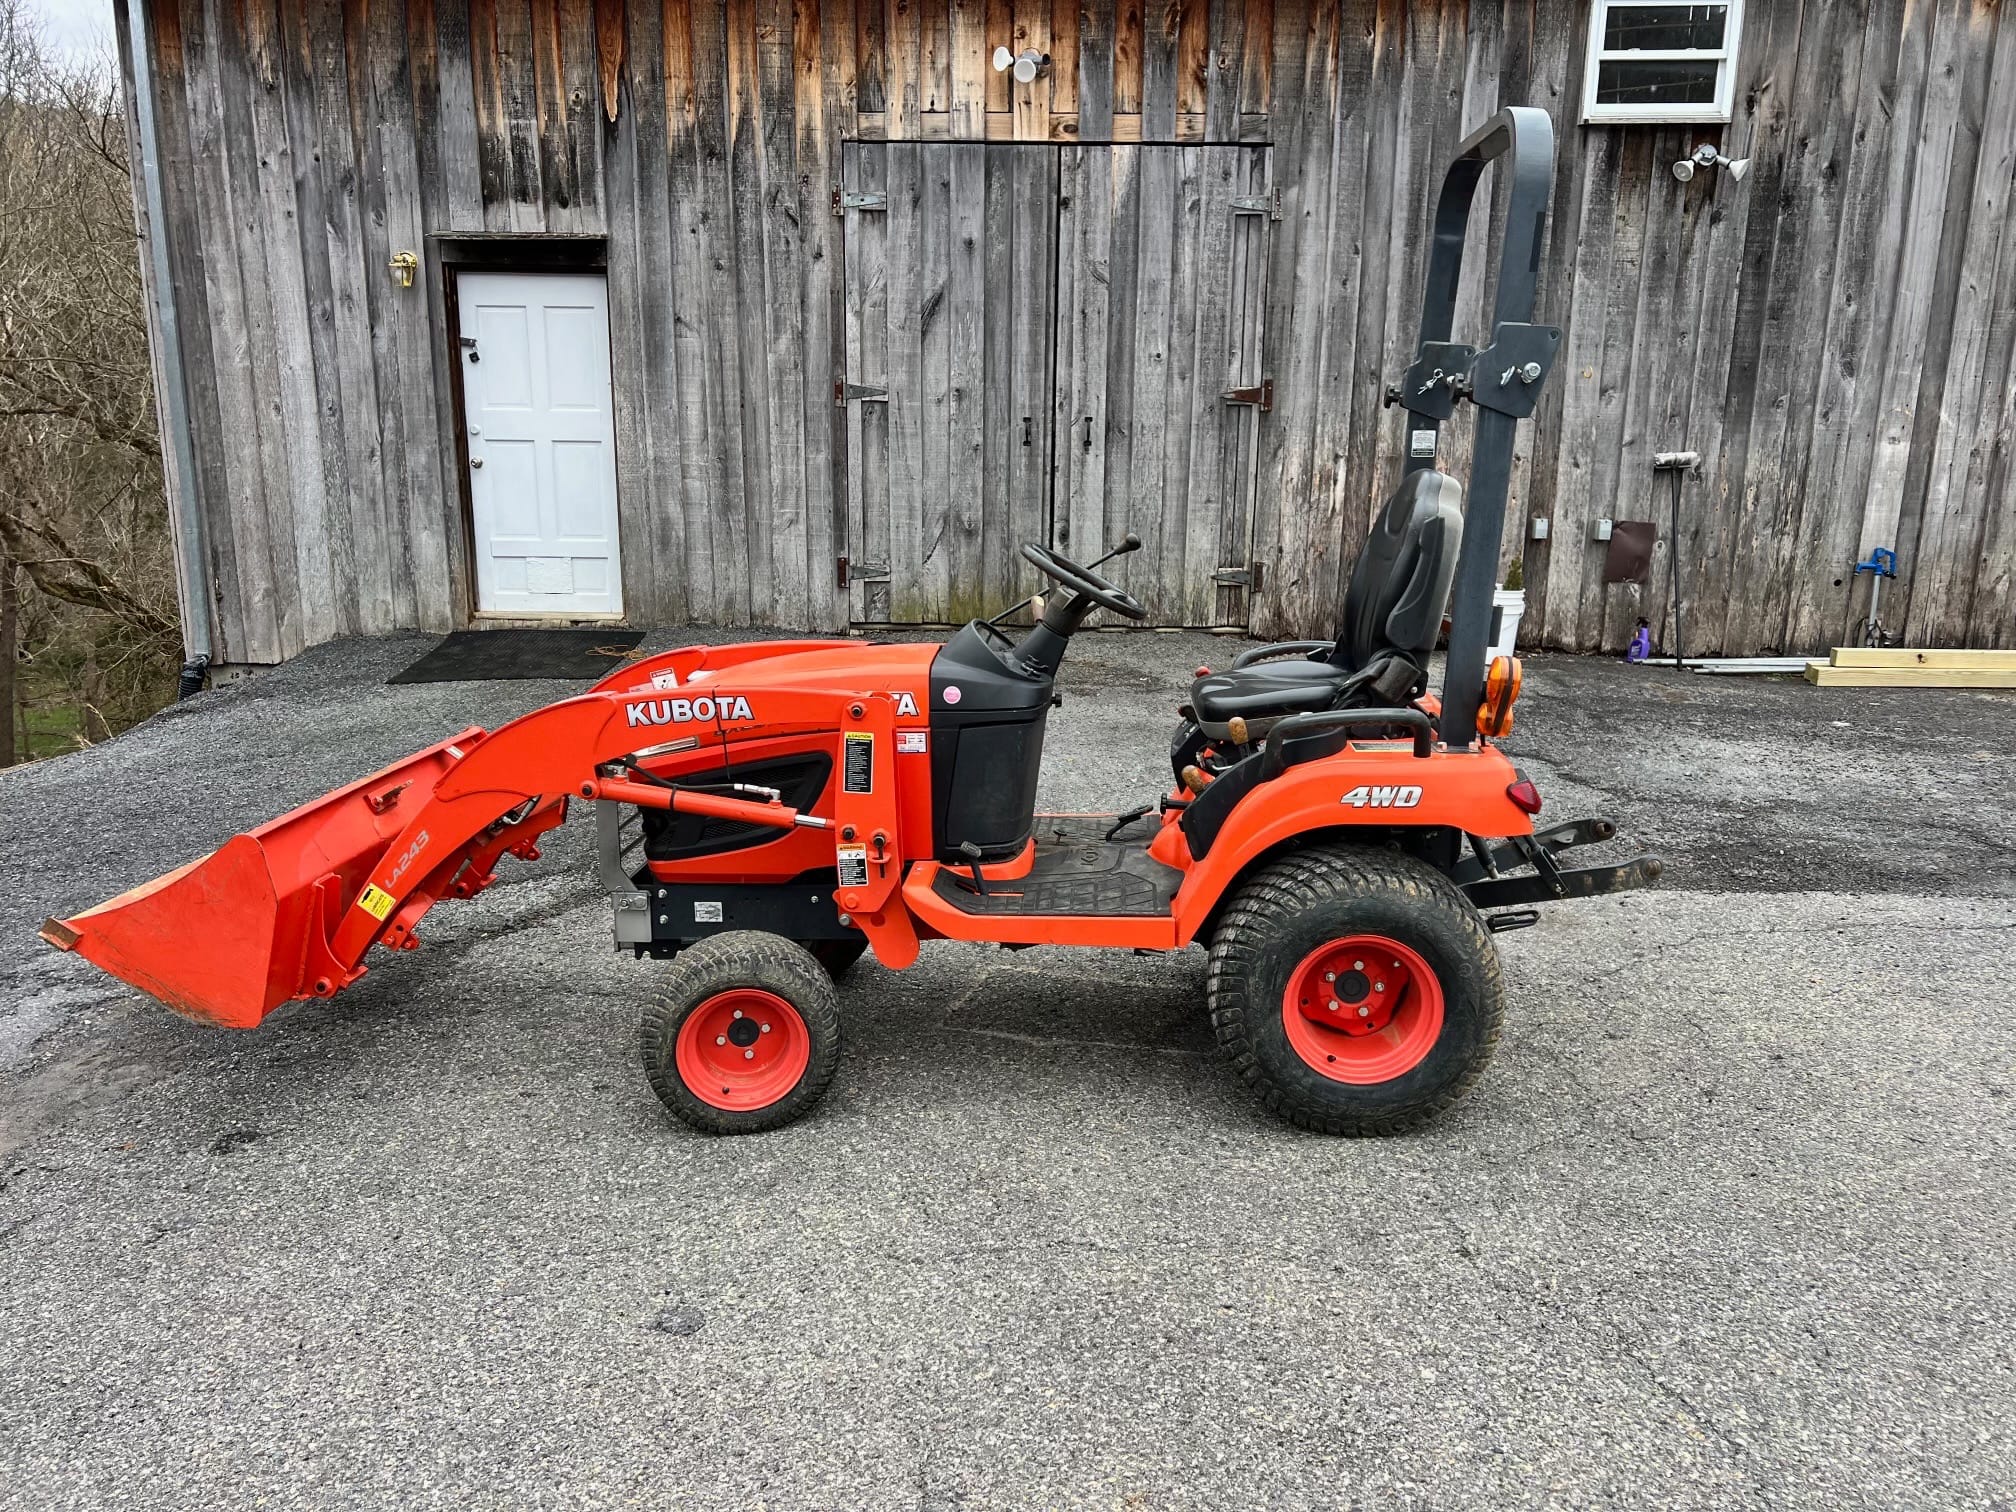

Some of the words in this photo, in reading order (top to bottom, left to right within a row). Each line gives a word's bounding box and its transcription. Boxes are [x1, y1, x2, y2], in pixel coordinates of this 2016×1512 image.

[626, 696, 755, 728] KUBOTA
[1340, 785, 1423, 808] 4WD
[385, 830, 430, 888] LA243
